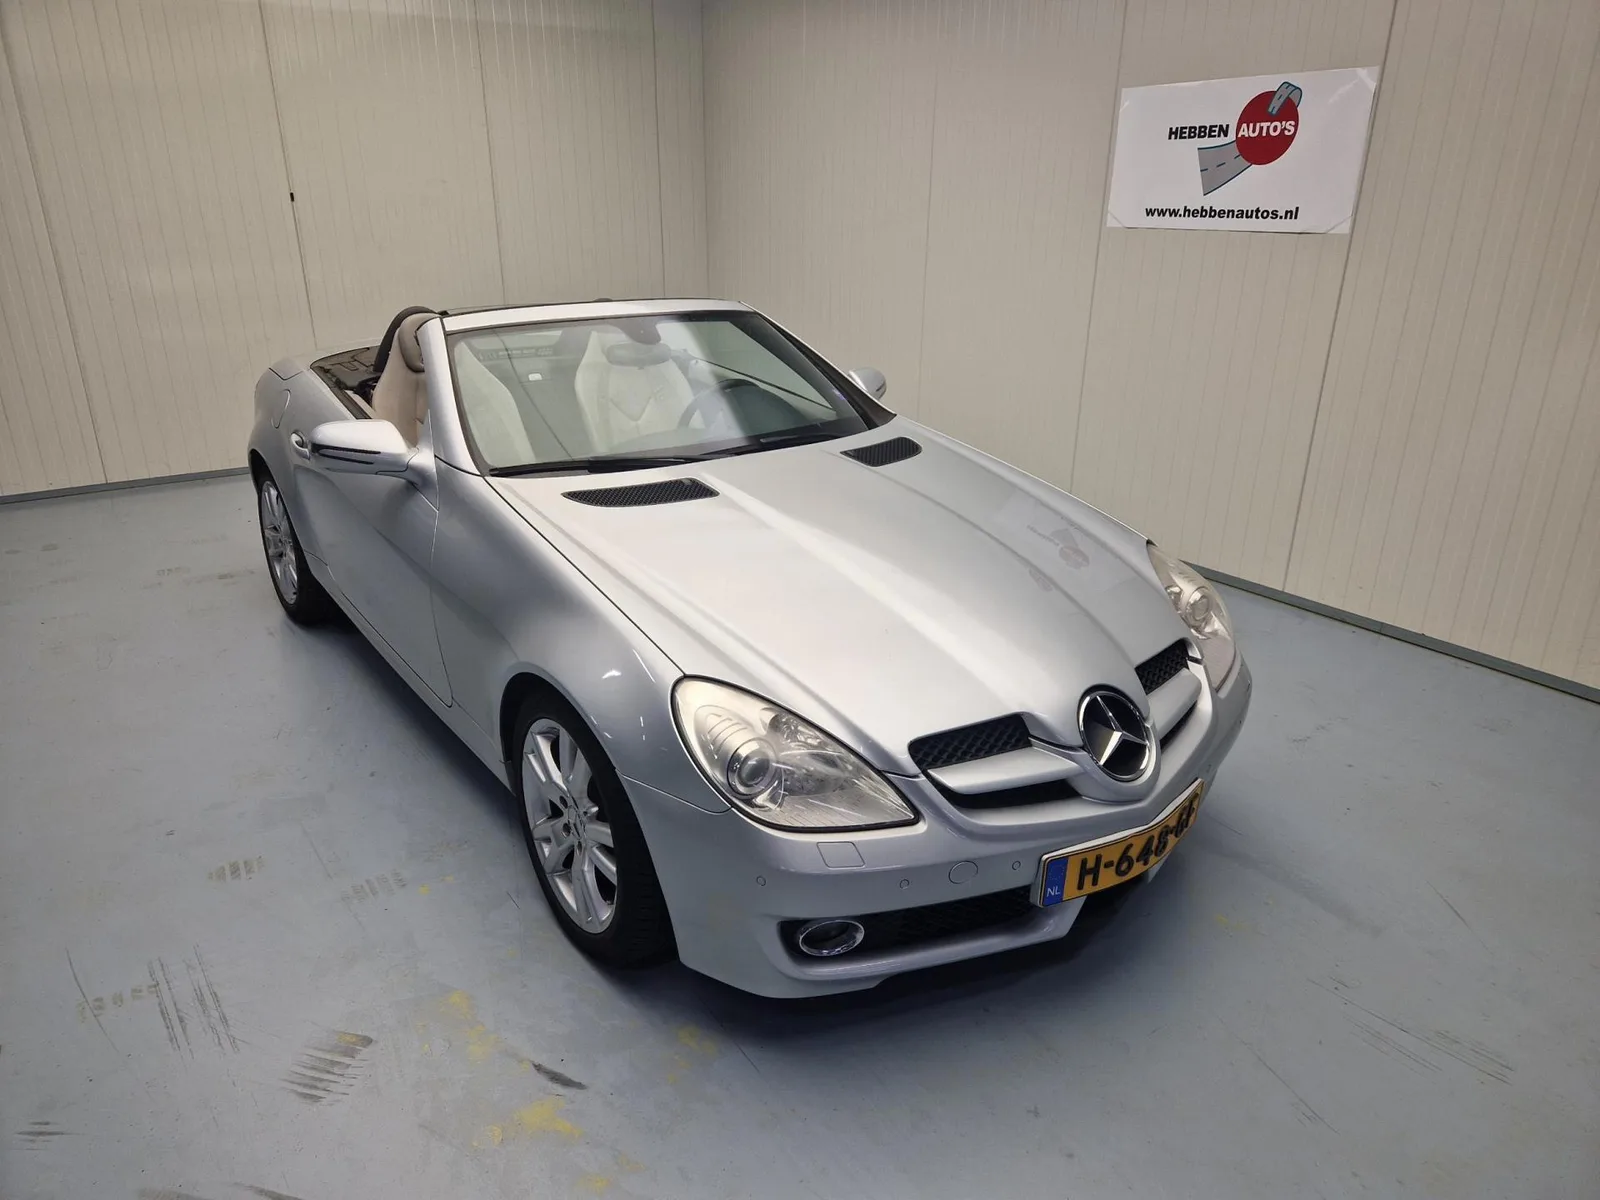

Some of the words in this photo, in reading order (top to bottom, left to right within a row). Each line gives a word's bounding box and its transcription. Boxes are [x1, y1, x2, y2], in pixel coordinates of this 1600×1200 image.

[1168, 124, 1230, 140] HEBBEN
[1237, 120, 1296, 138] AUTO'S
[1145, 206, 1300, 220] www.hebbenautos.nl
[1046, 886, 1061, 897] NL
